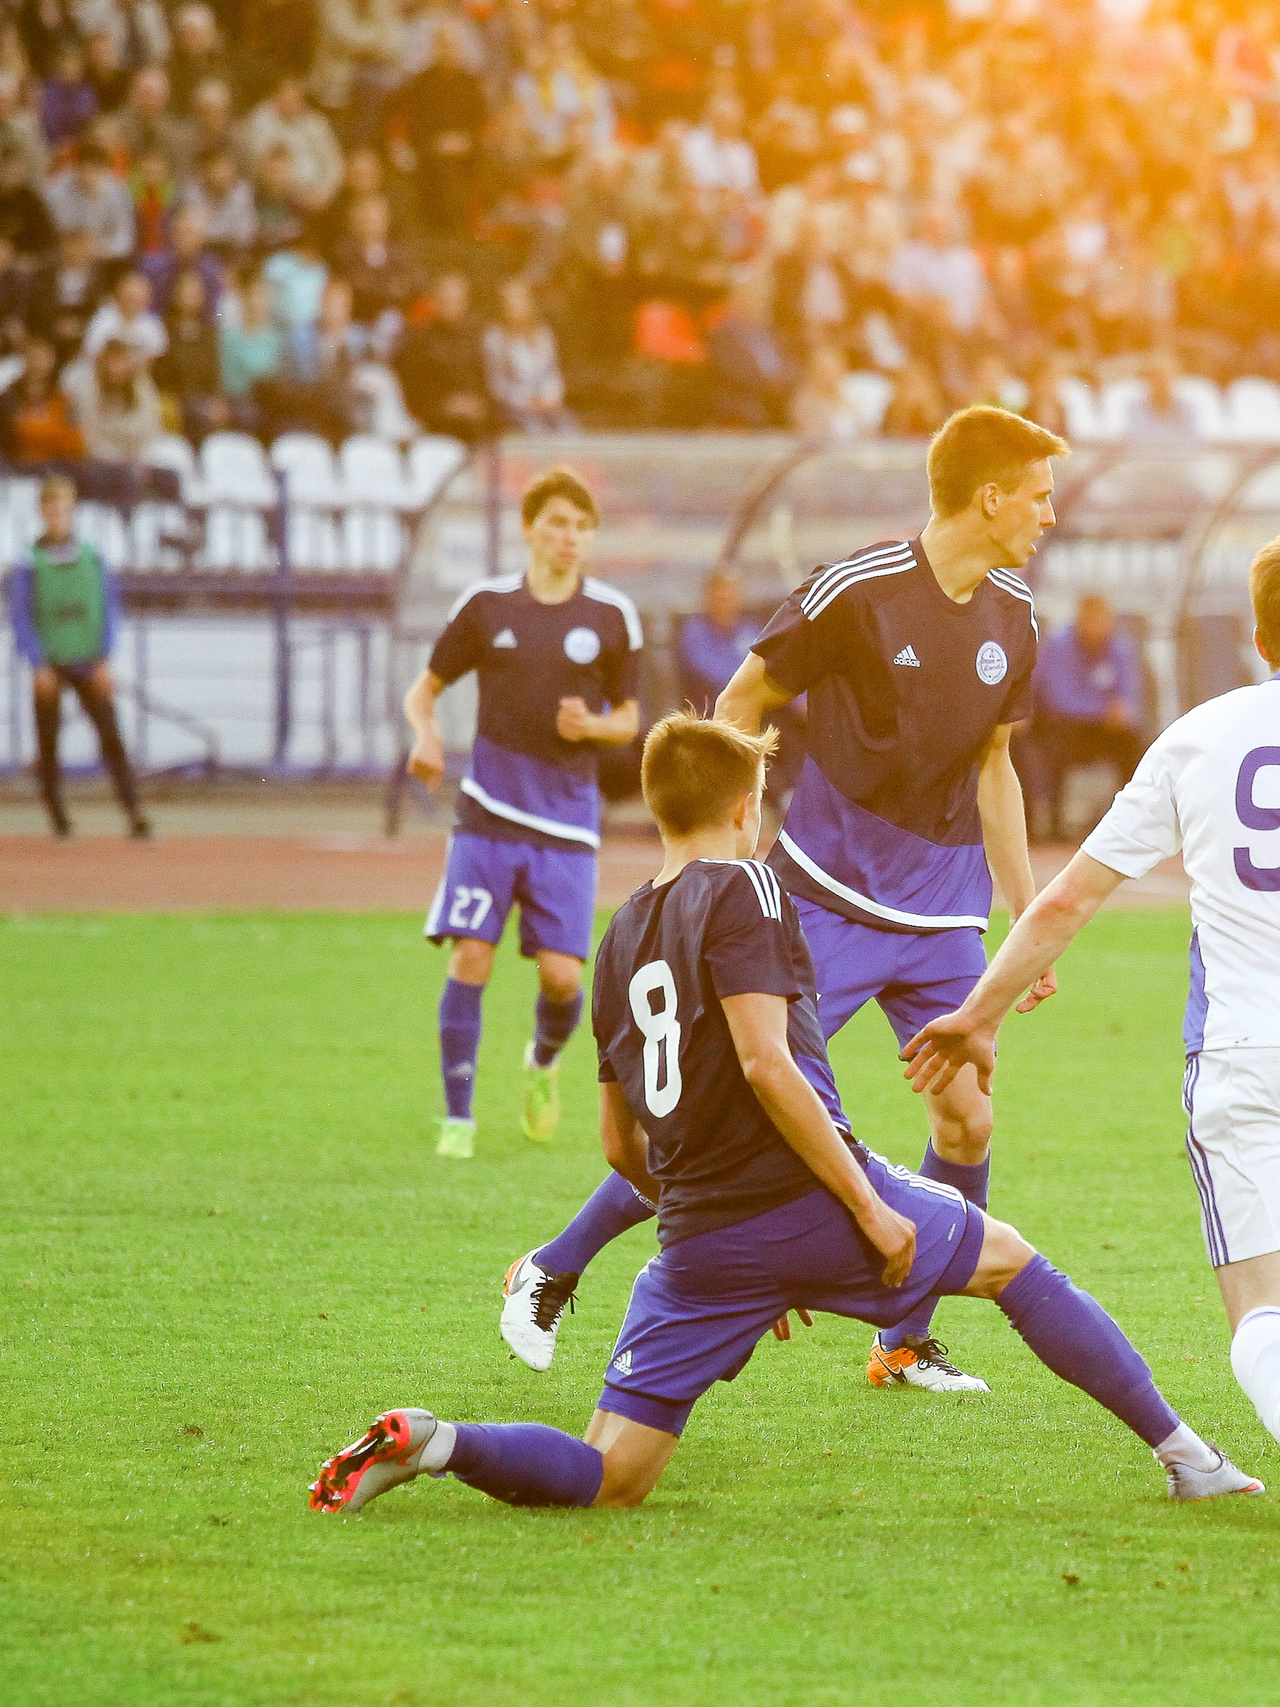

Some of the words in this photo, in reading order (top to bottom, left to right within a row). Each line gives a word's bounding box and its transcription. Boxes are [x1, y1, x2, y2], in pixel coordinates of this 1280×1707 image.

[893, 657, 922, 668] adidas
[449, 885, 493, 930] 27
[628, 959, 682, 1119] 8
